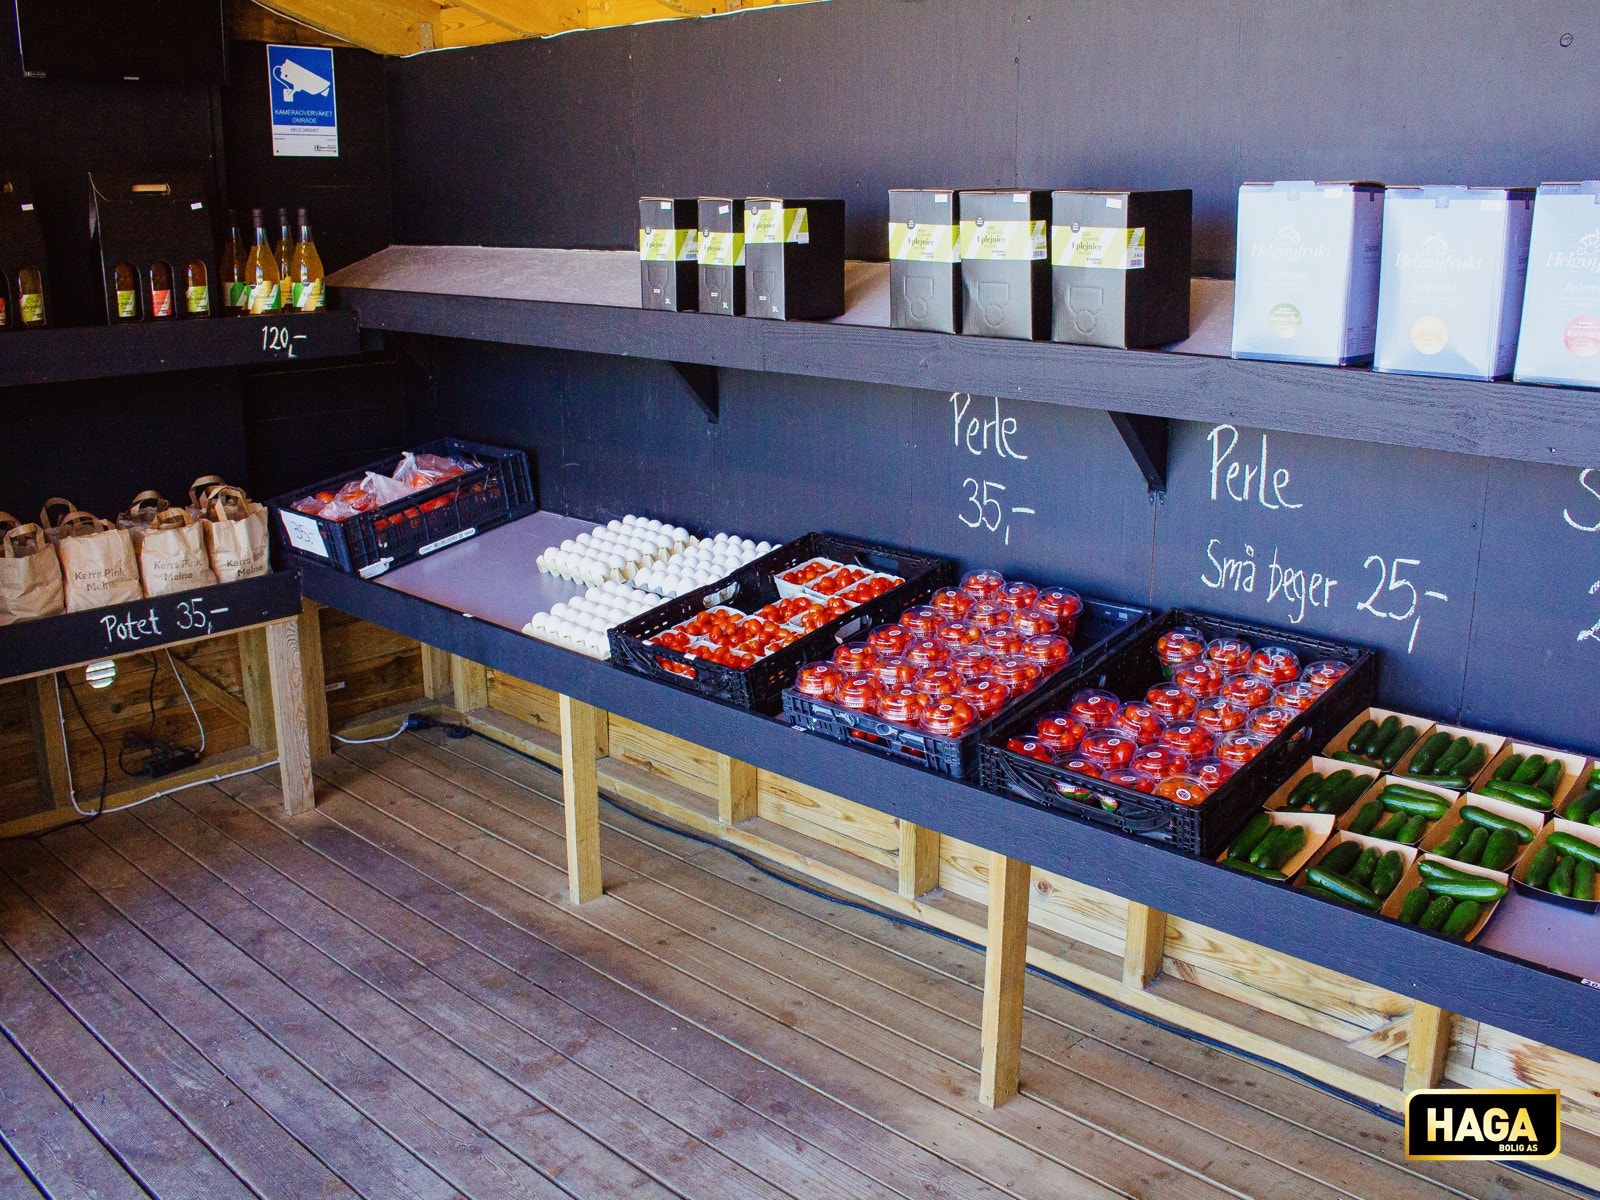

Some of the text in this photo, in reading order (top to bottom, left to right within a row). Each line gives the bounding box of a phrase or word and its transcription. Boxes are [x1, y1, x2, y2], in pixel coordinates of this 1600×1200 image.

[949, 392, 1028, 460] Perle
[1206, 424, 1303, 510] Perle
[958, 478, 1036, 545] 35,-
[1200, 538, 1257, 592] Små
[1266, 547, 1338, 624] beger
[100, 607, 162, 643] Potet
